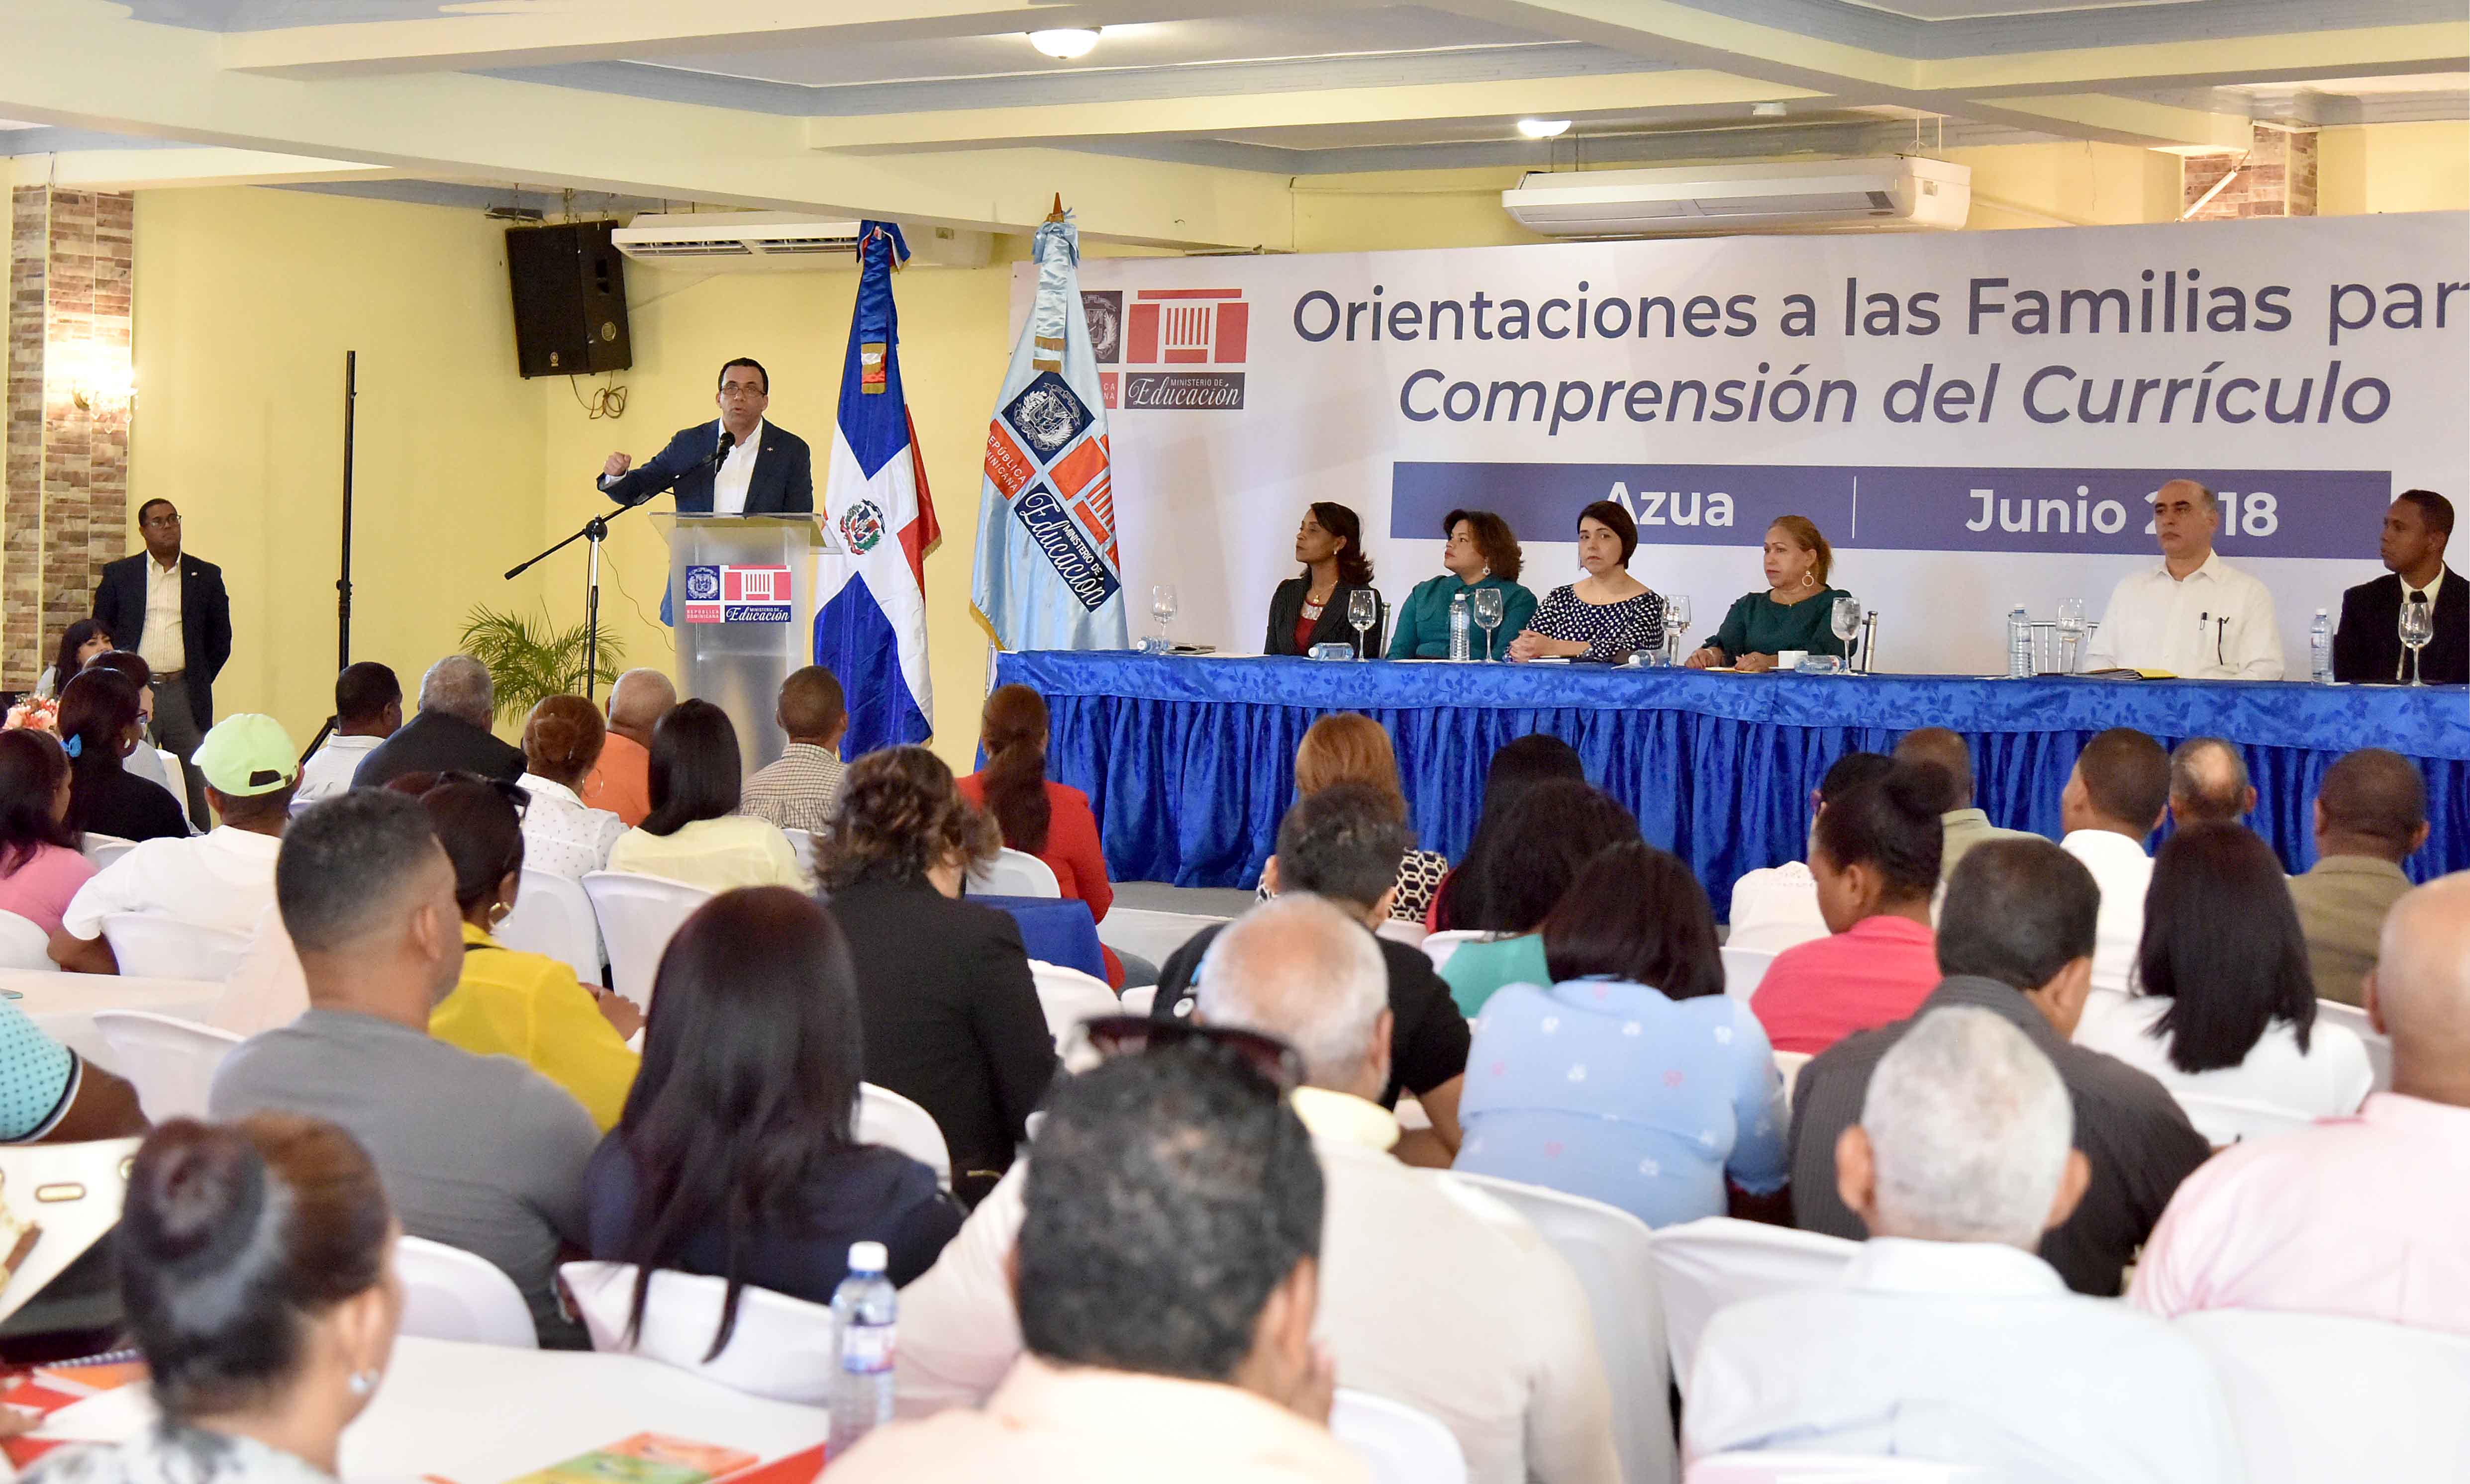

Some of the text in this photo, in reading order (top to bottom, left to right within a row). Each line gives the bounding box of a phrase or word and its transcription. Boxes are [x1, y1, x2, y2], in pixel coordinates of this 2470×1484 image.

[1294, 269, 2470, 346] Orientaciones a las Familias par
[1128, 376, 1241, 406] Educación
[1400, 361, 2390, 435] Comprensión del Currículo
[986, 450, 1018, 491] MINICANA
[988, 432, 1027, 483] EPÚBLICA
[1607, 481, 1734, 526] Azua
[1966, 486, 2126, 533] Junio
[1019, 492, 1105, 606] Educación
[1064, 525, 1102, 575] MINISTERIO DE
[726, 606, 790, 621] Educación
